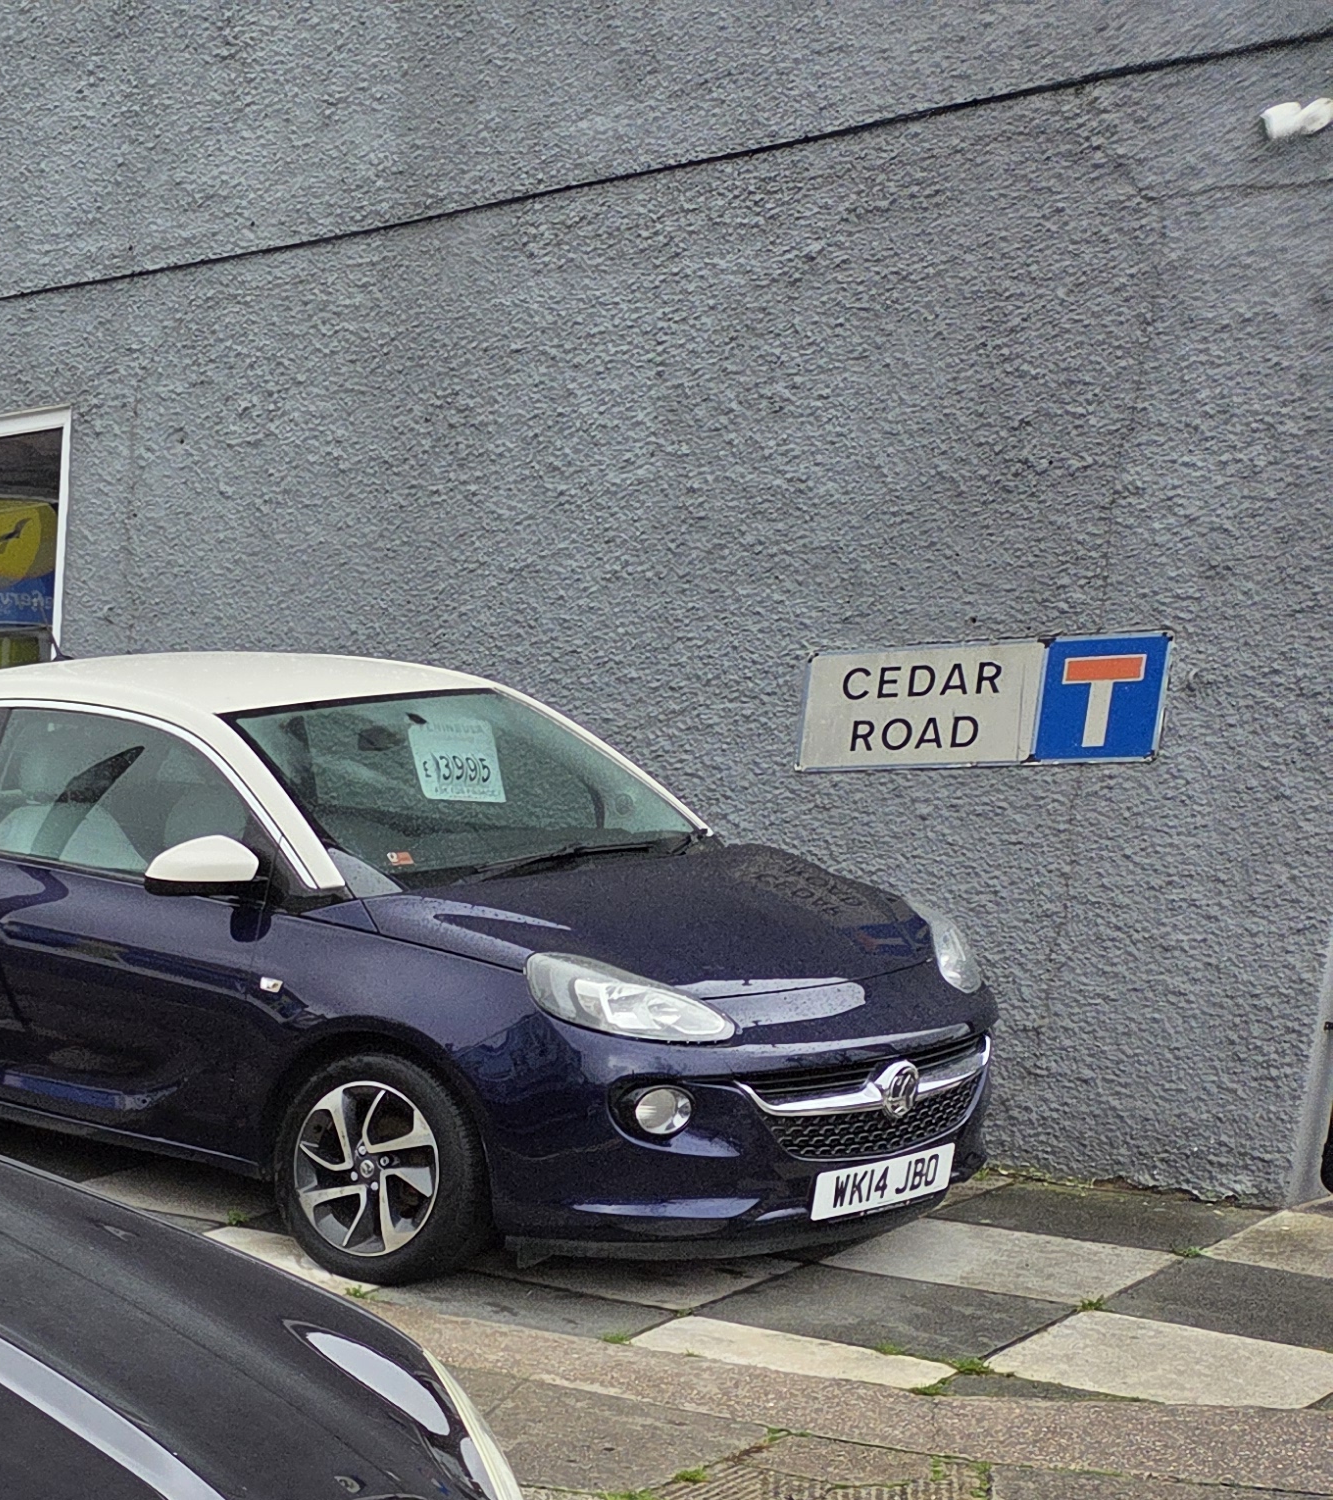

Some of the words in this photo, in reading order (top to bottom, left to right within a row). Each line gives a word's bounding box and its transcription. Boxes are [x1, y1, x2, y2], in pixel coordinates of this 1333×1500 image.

[842, 660, 1003, 701] CEDAR
[849, 714, 981, 752] ROAD
[833, 1165, 890, 1209] WK14
[895, 1153, 940, 1195] JBO
